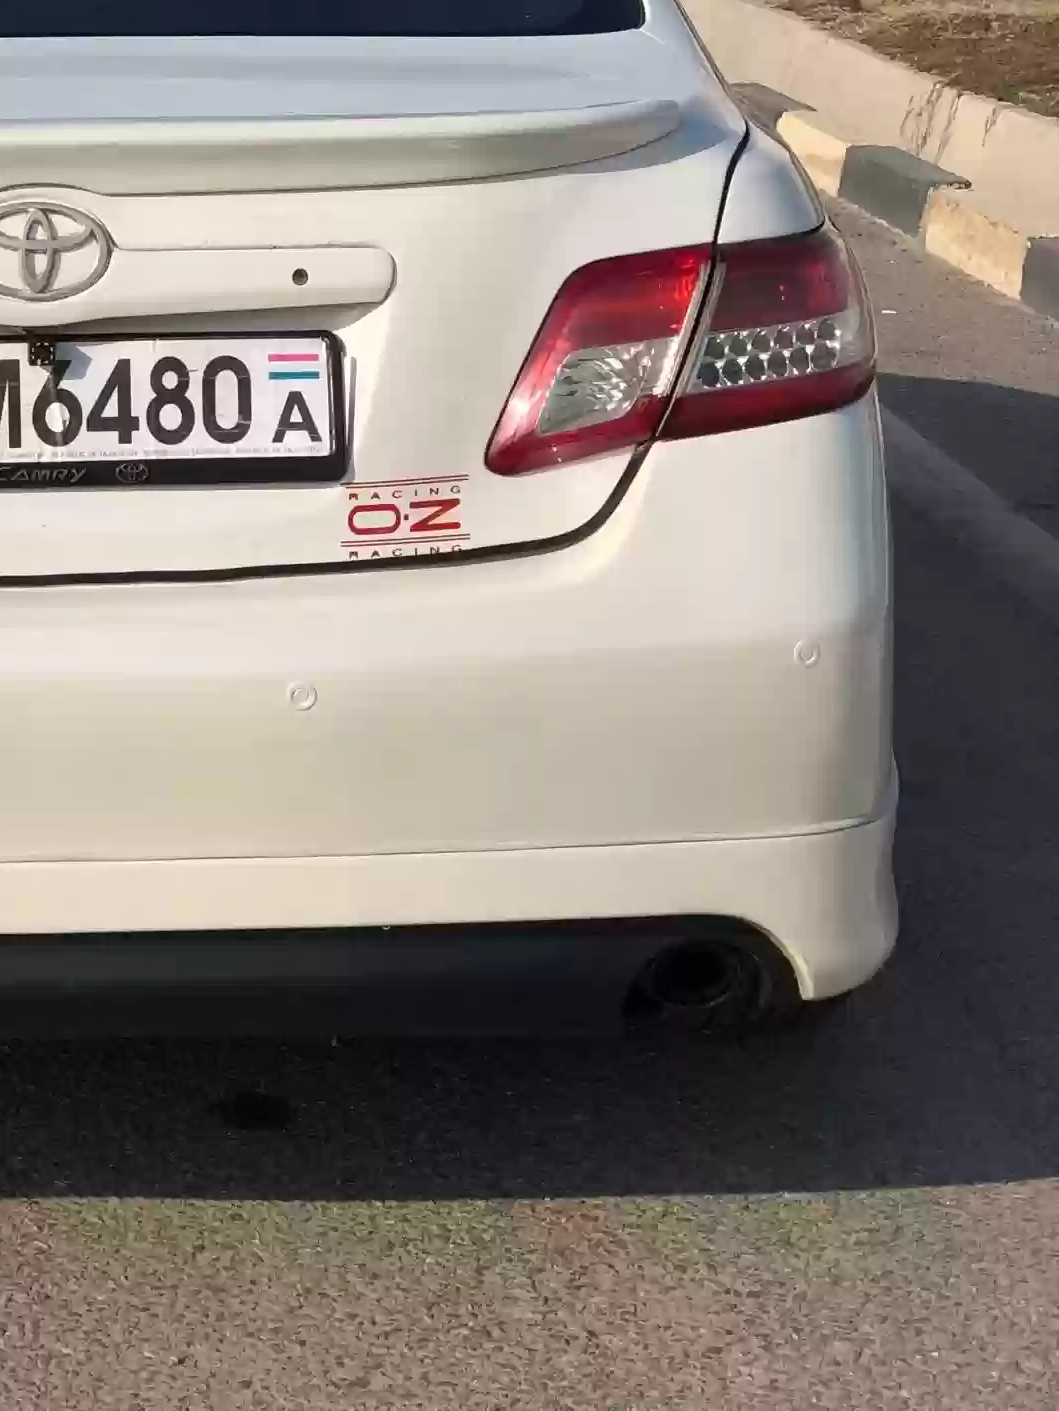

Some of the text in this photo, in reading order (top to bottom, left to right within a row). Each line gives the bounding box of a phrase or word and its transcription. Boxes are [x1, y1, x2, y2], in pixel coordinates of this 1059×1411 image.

[272, 391, 323, 444] A
[348, 485, 461, 500] RACING
[348, 545, 463, 559] RACING
